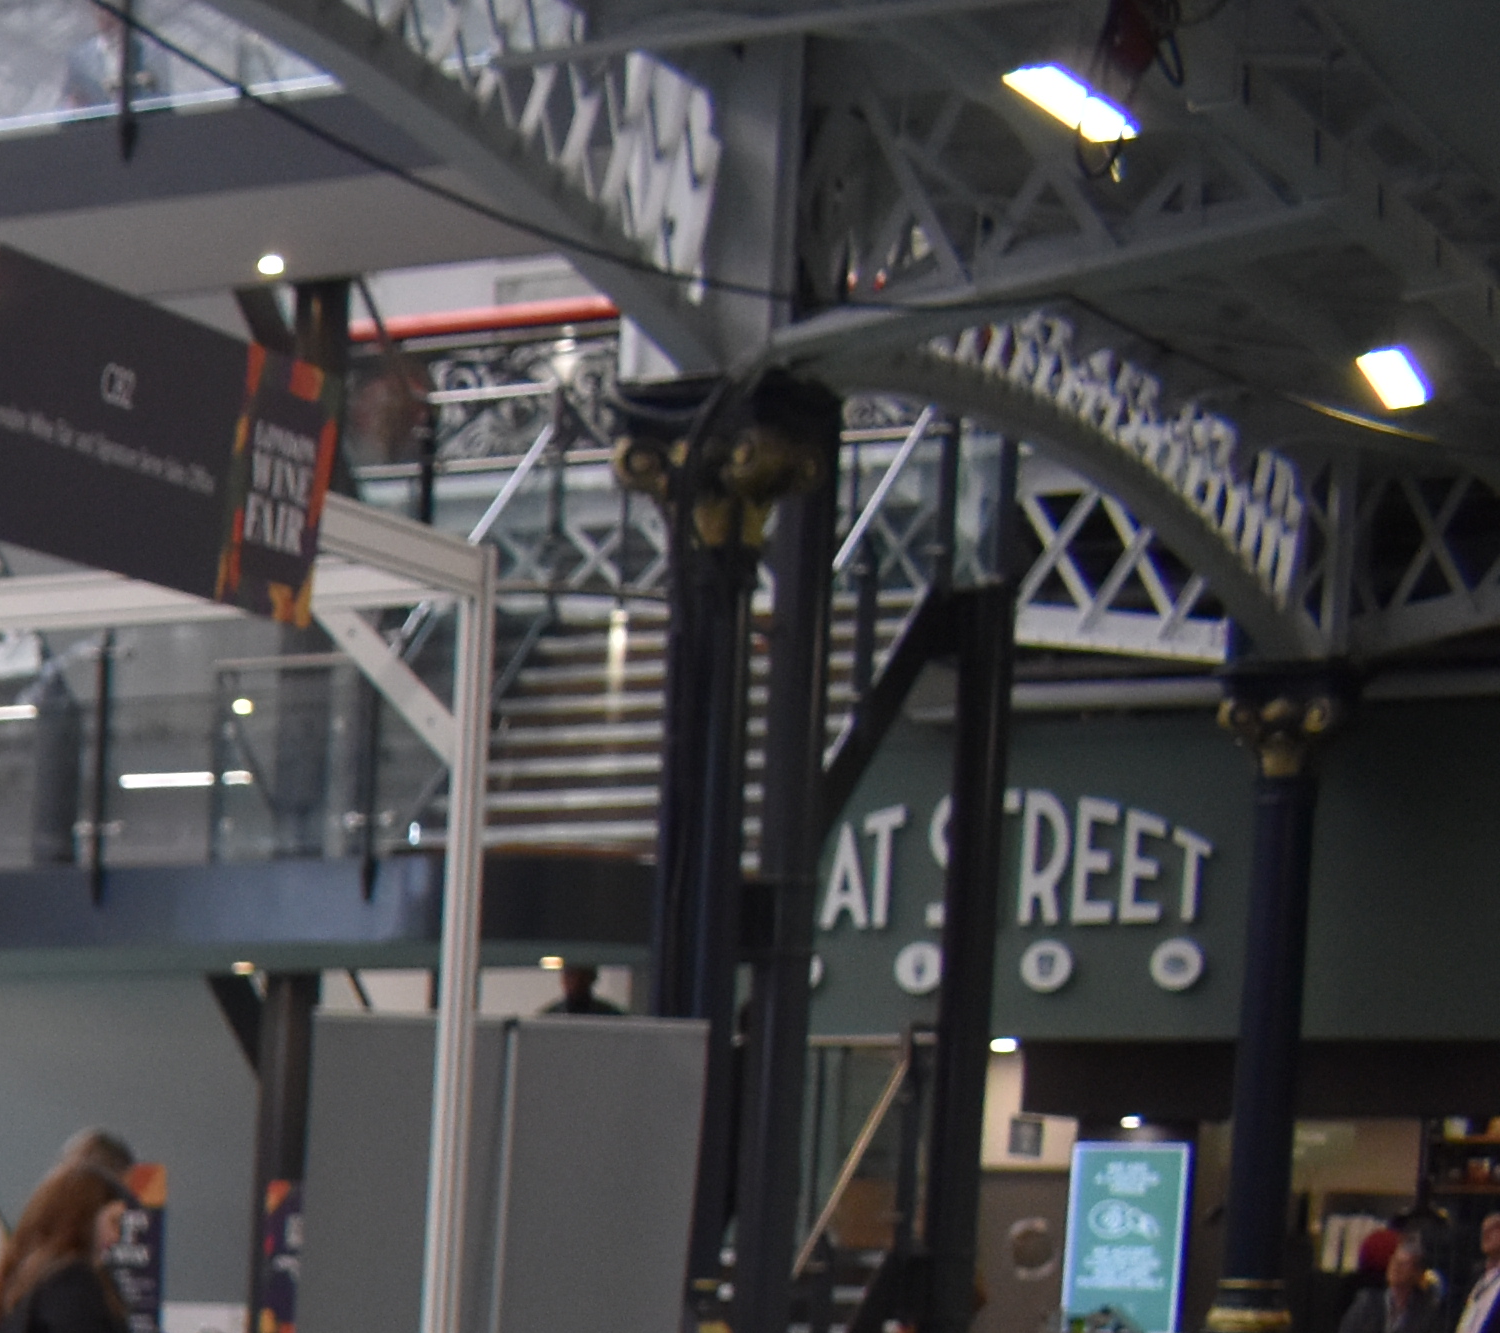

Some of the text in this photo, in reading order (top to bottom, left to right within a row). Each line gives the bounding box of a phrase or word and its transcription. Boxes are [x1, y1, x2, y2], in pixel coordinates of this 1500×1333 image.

[252, 450, 314, 508] WINE
[244, 491, 306, 557] FAIR
[926, 788, 1214, 930] REET
